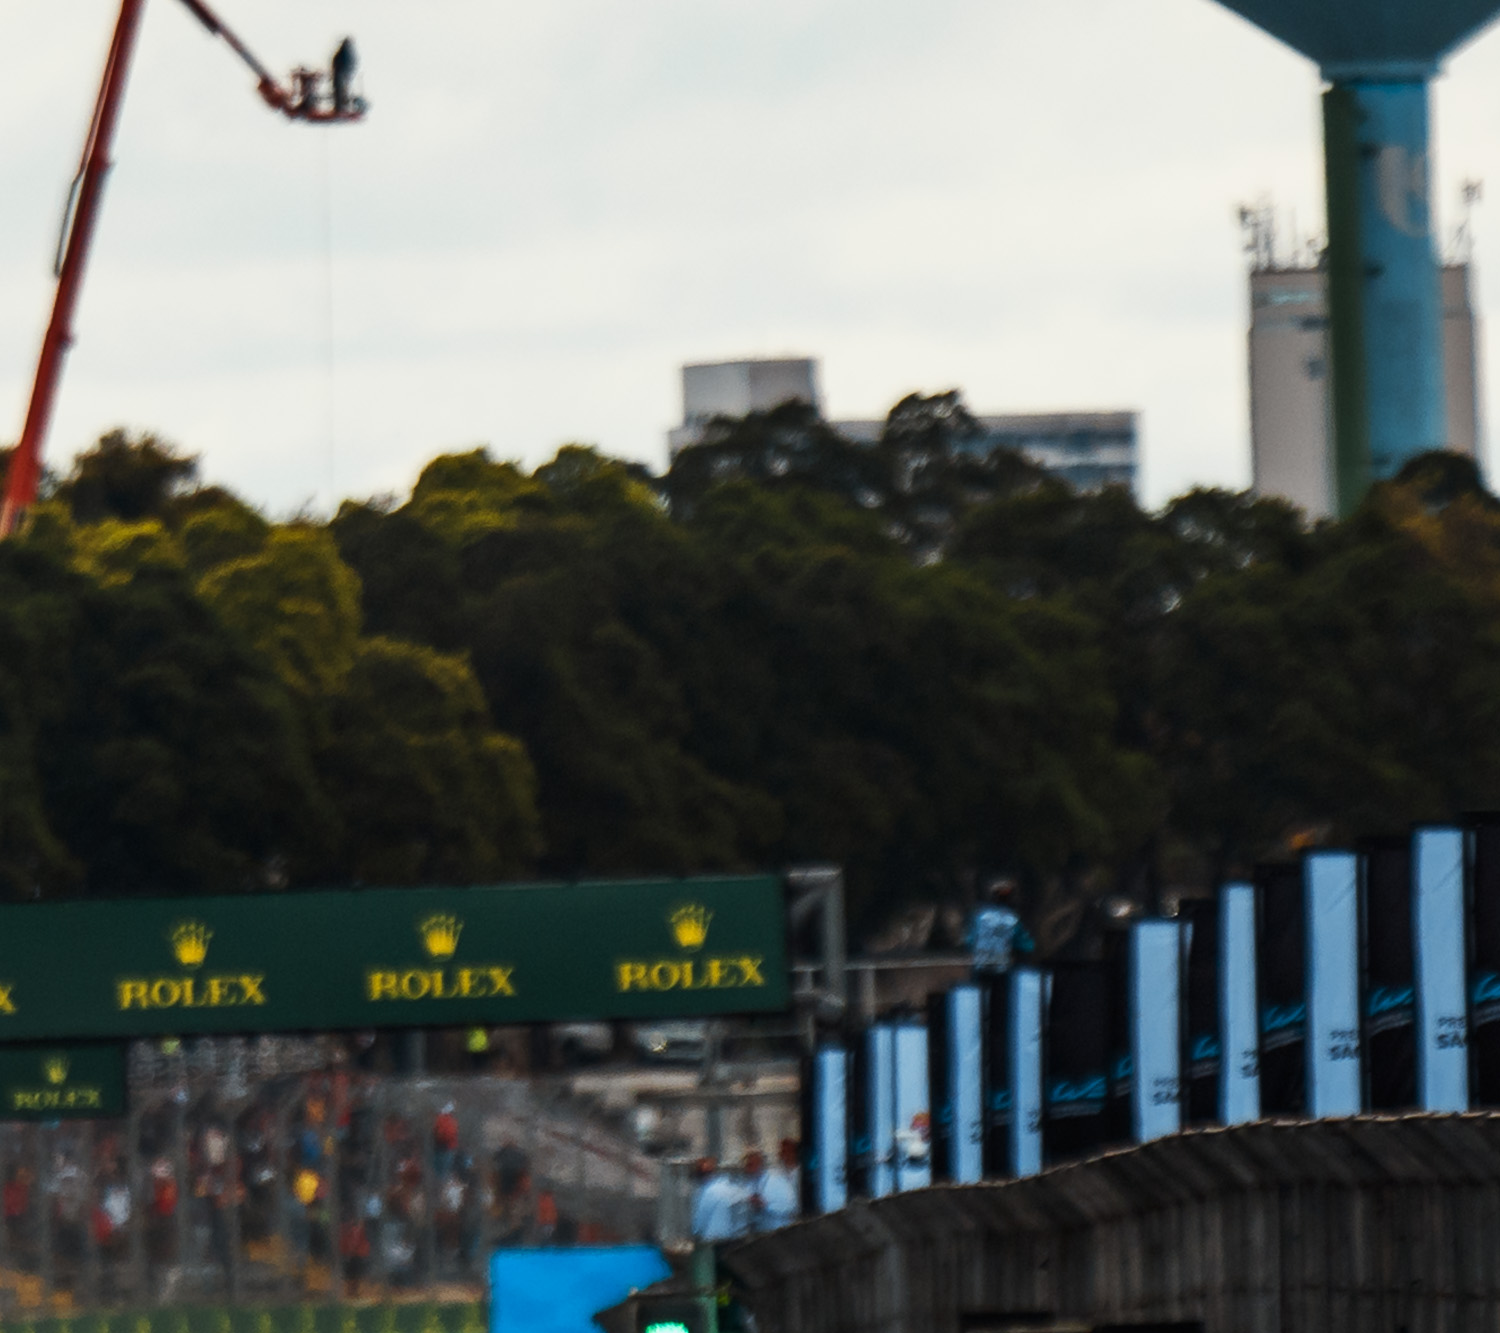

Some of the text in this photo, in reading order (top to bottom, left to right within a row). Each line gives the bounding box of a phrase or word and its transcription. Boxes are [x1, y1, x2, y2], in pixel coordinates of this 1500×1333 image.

[368, 966, 514, 1001] ROLEX
[618, 956, 764, 992] ROLEX
[118, 975, 265, 1011] ROLEX
